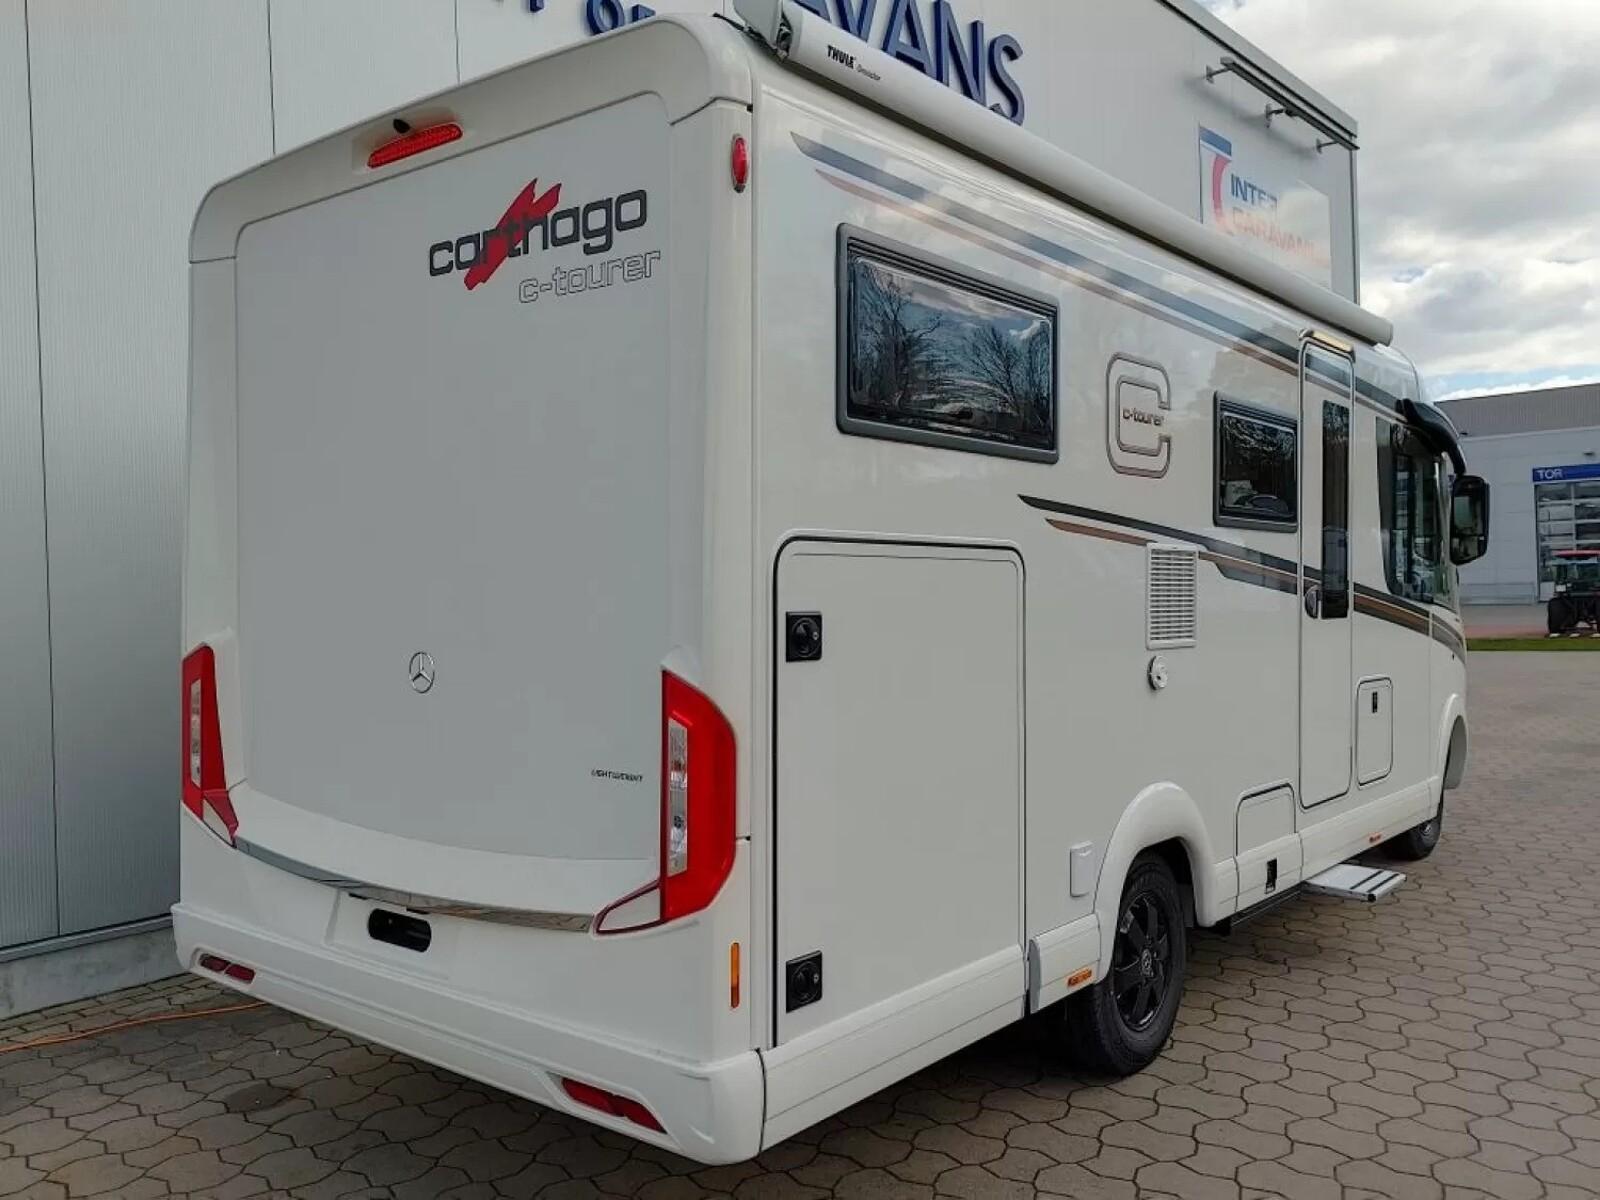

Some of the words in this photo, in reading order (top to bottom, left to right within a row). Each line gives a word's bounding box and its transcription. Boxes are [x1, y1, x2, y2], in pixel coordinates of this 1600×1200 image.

[827, 44, 854, 69] THULE
[429, 189, 648, 277] carthago
[518, 250, 661, 304] c-tourer
[1536, 468, 1563, 480] TOR
